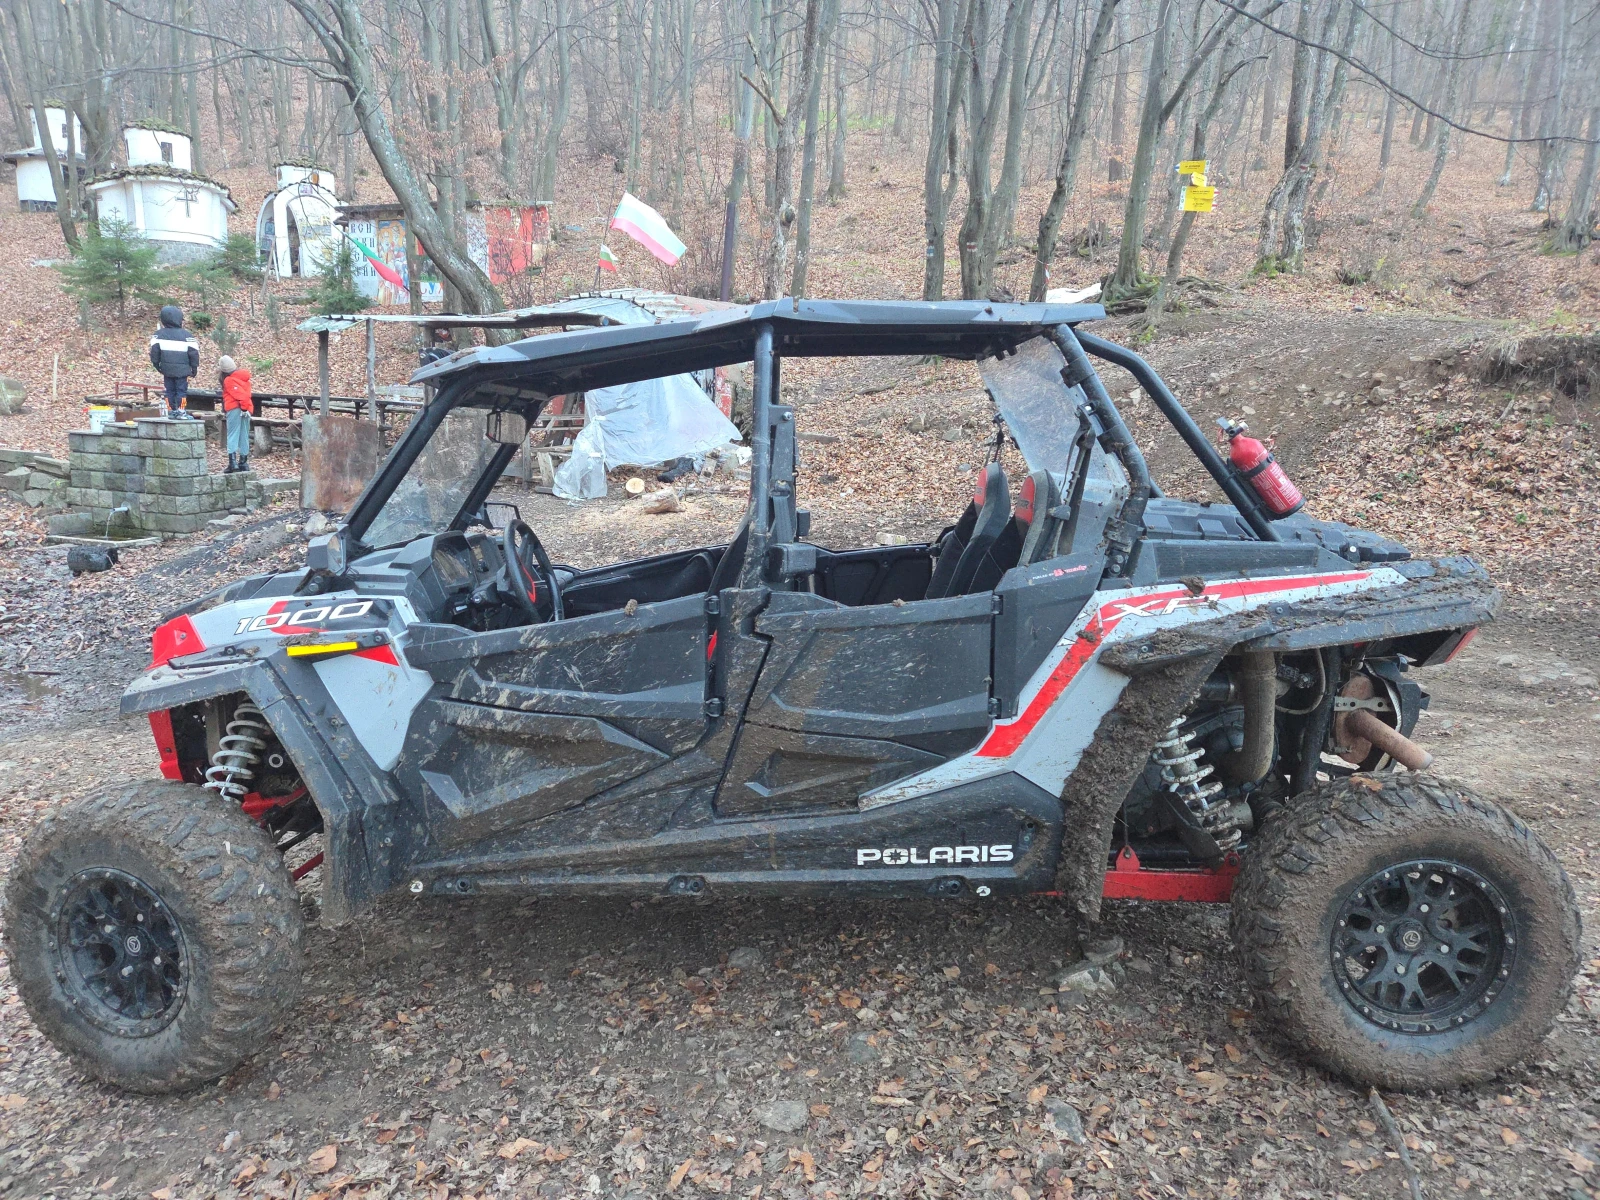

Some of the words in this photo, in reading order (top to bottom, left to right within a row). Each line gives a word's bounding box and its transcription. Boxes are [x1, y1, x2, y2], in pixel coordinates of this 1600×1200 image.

[234, 601, 374, 635] 1000
[1102, 594, 1221, 622] XP
[856, 844, 1014, 866] POLARIS
